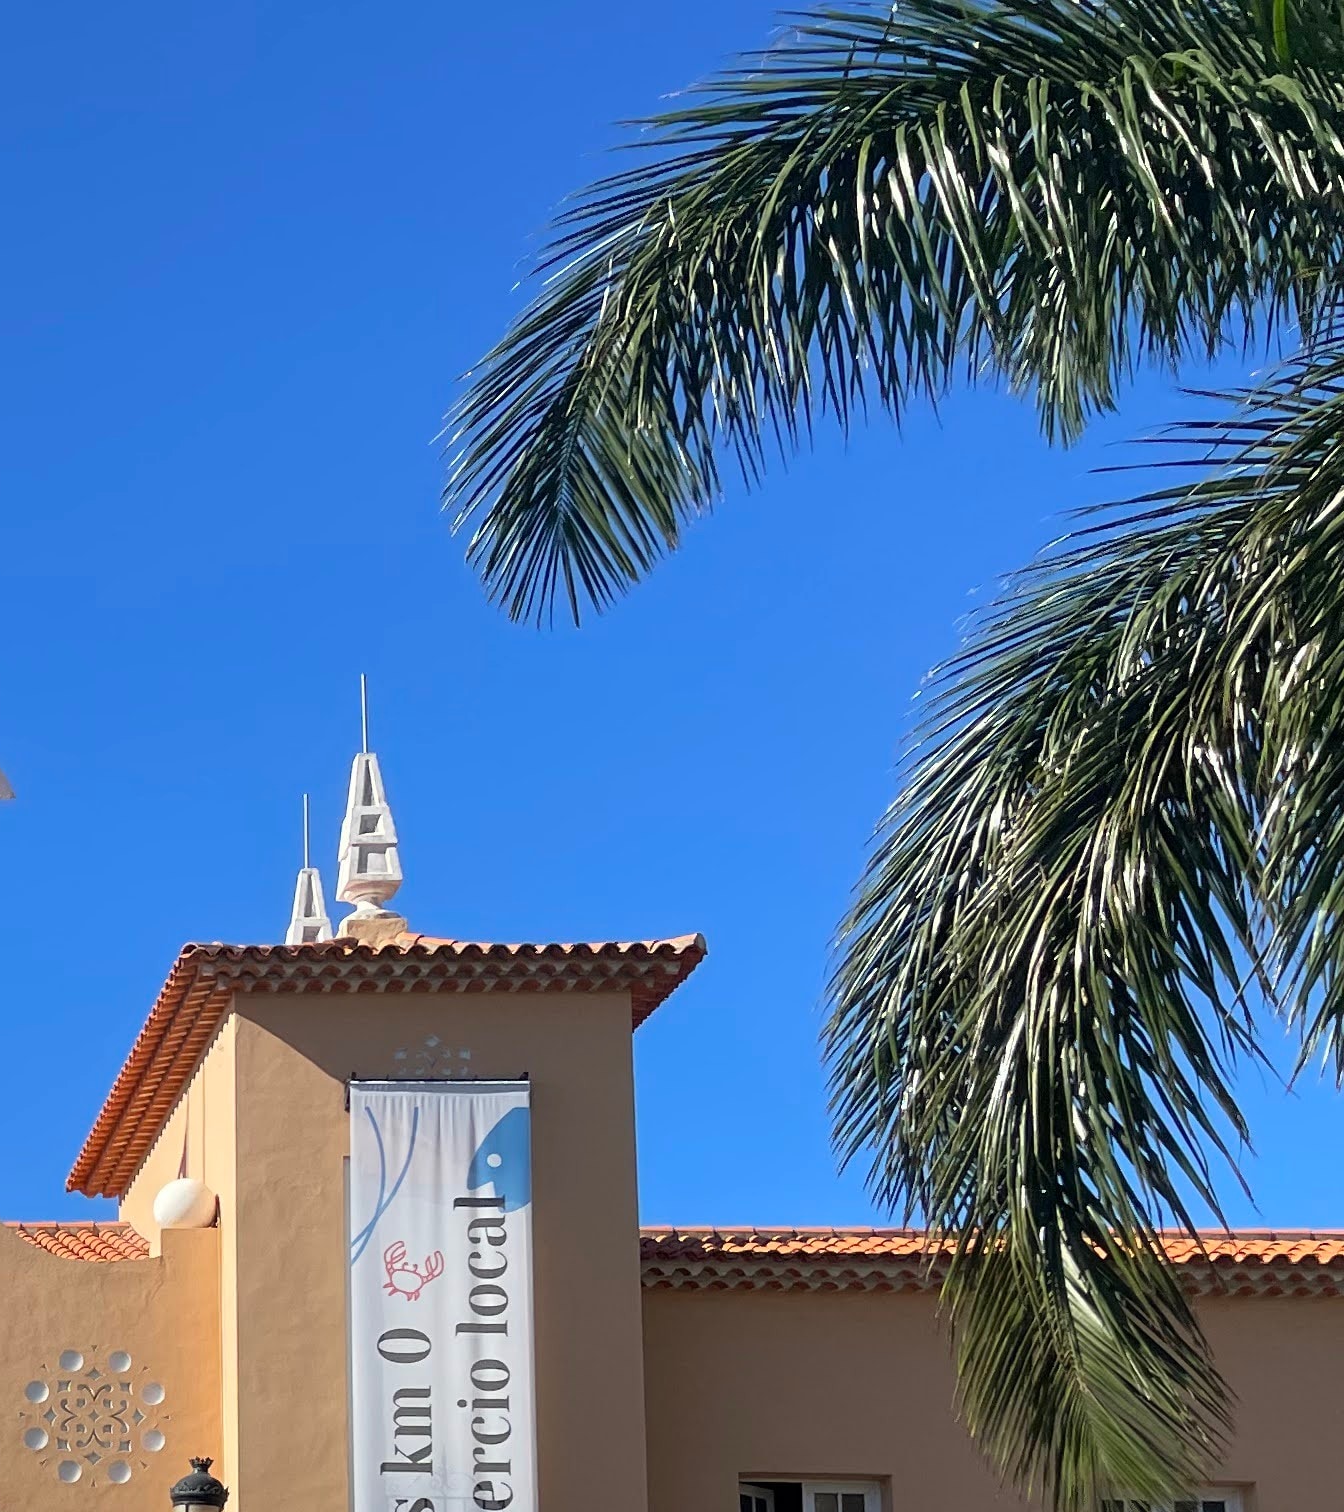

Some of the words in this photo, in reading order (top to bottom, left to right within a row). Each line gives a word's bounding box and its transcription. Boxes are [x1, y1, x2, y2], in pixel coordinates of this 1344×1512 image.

[453, 1194, 509, 1337] local
[377, 1327, 432, 1364] 0
[379, 1385, 433, 1476] km
